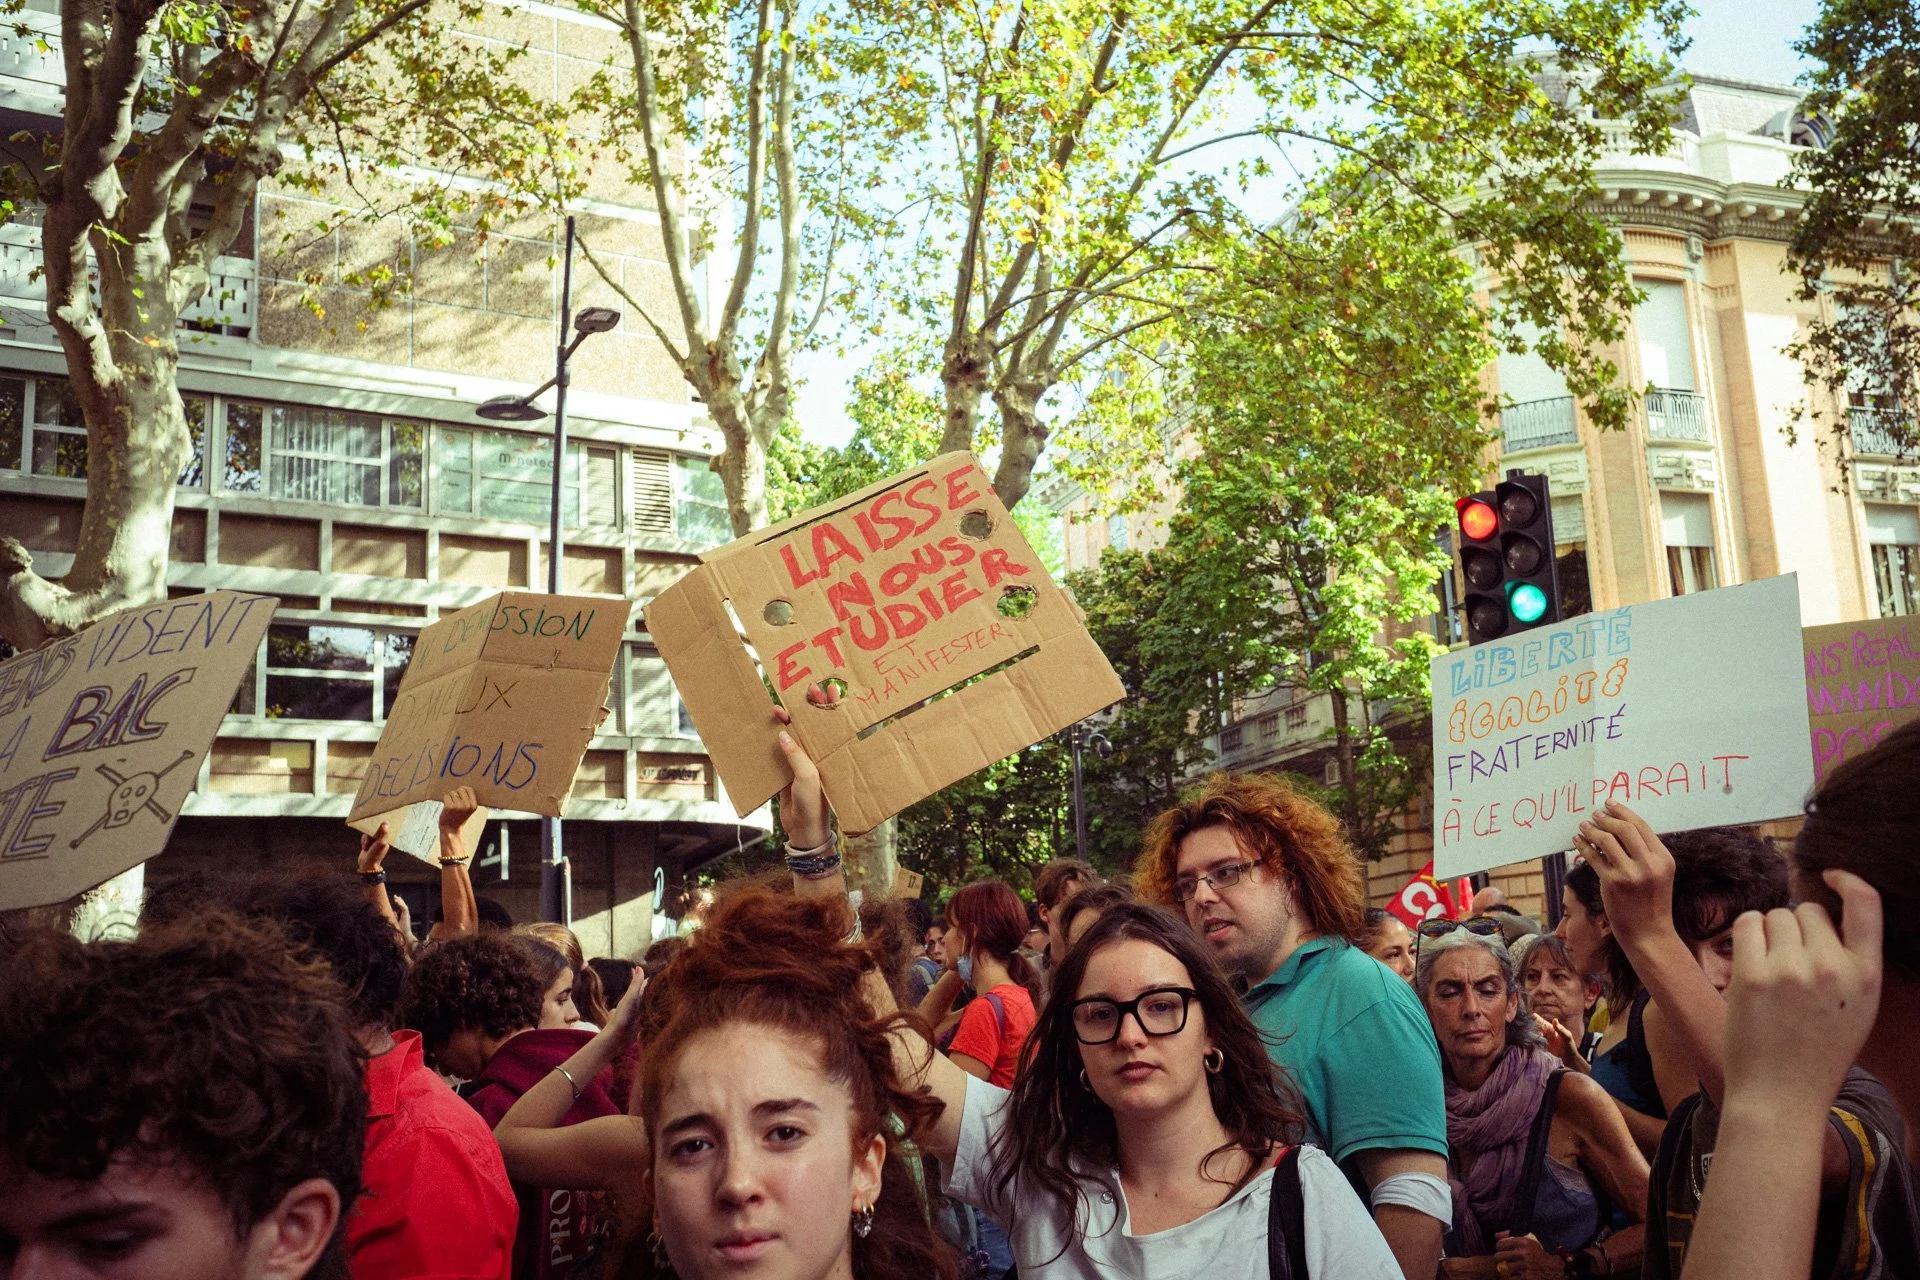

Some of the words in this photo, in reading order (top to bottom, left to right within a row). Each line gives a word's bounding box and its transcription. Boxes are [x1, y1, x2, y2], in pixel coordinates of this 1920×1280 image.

[780, 464, 995, 589] LAISSE
[773, 548, 1031, 692] ETUDIER
[826, 536, 976, 621] NOUS
[86, 595, 274, 672] VISENT
[856, 623, 1014, 710] MANIFESTER
[872, 639, 917, 675] ET
[42, 667, 197, 762] BAC
[1473, 803, 1503, 837] CE
